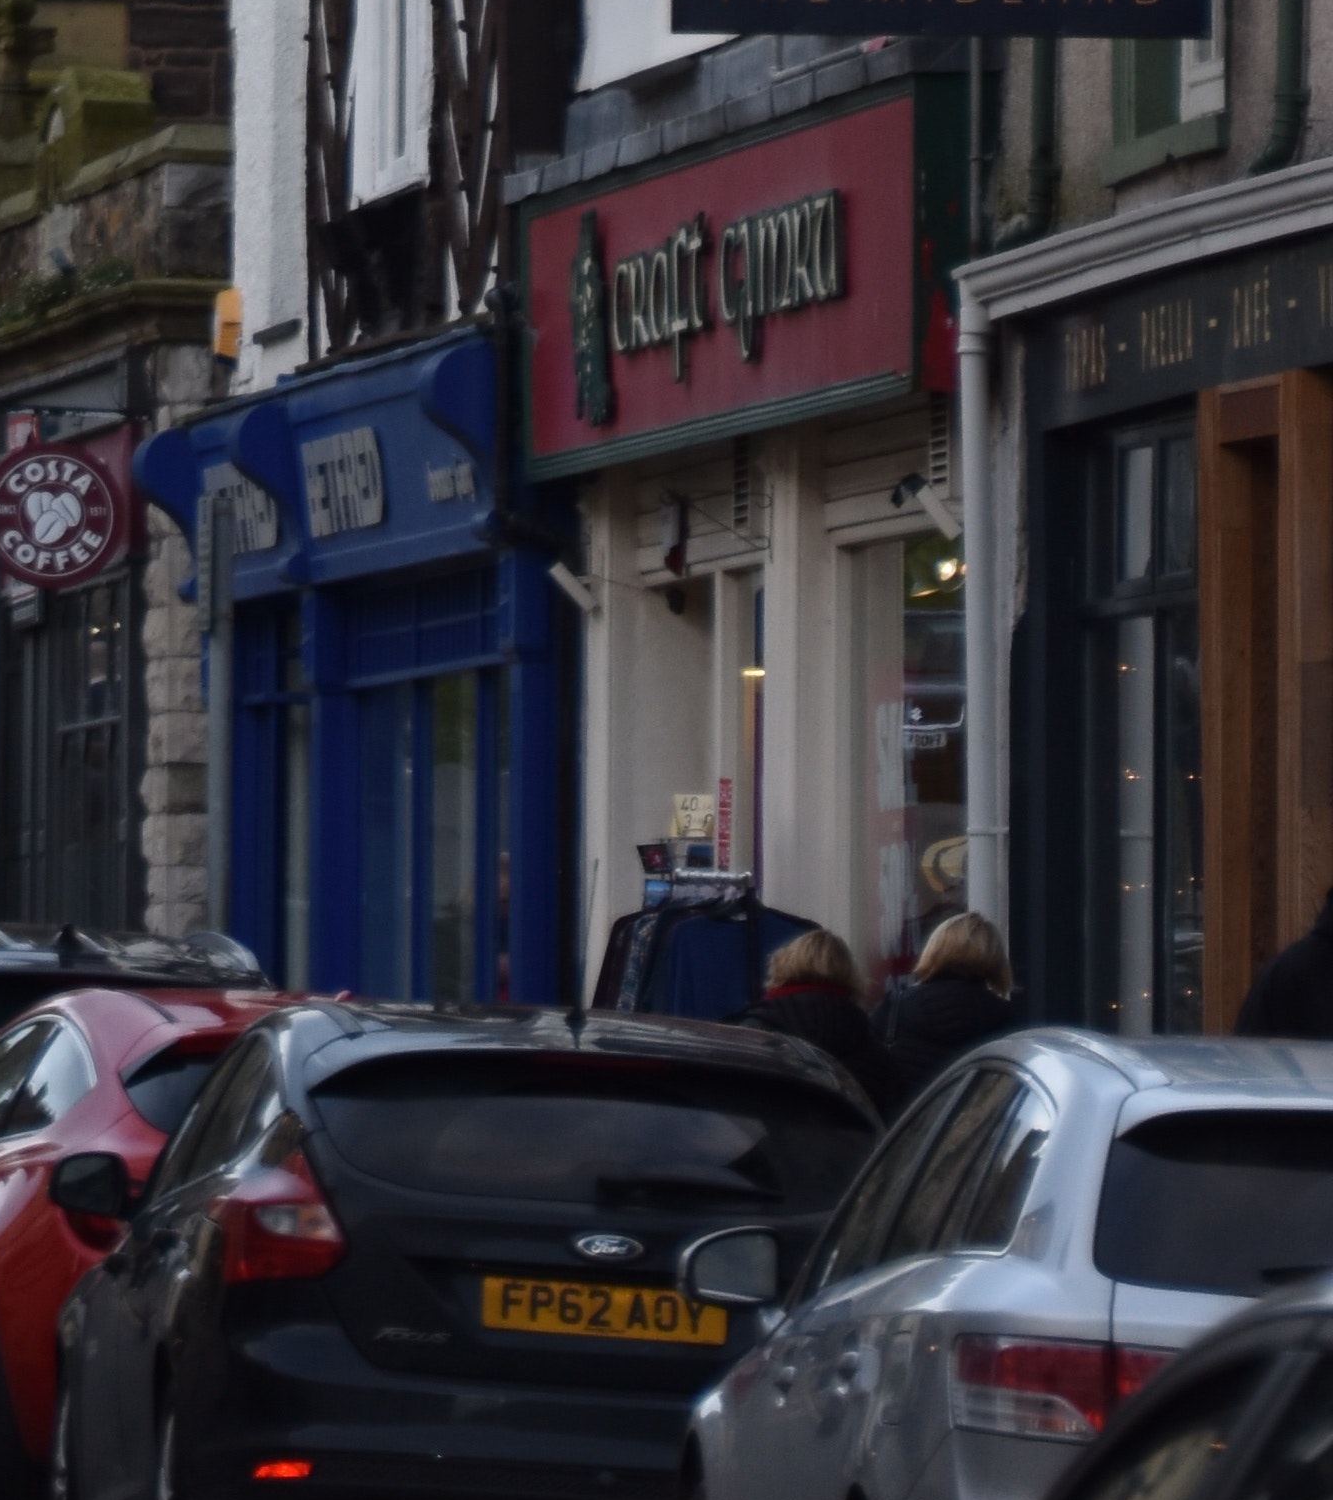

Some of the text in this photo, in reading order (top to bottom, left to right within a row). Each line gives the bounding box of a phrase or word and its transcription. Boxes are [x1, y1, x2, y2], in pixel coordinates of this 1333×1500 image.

[8, 459, 94, 496] COSTA
[2, 529, 103, 572] COFFEE
[501, 1281, 613, 1327] FP62
